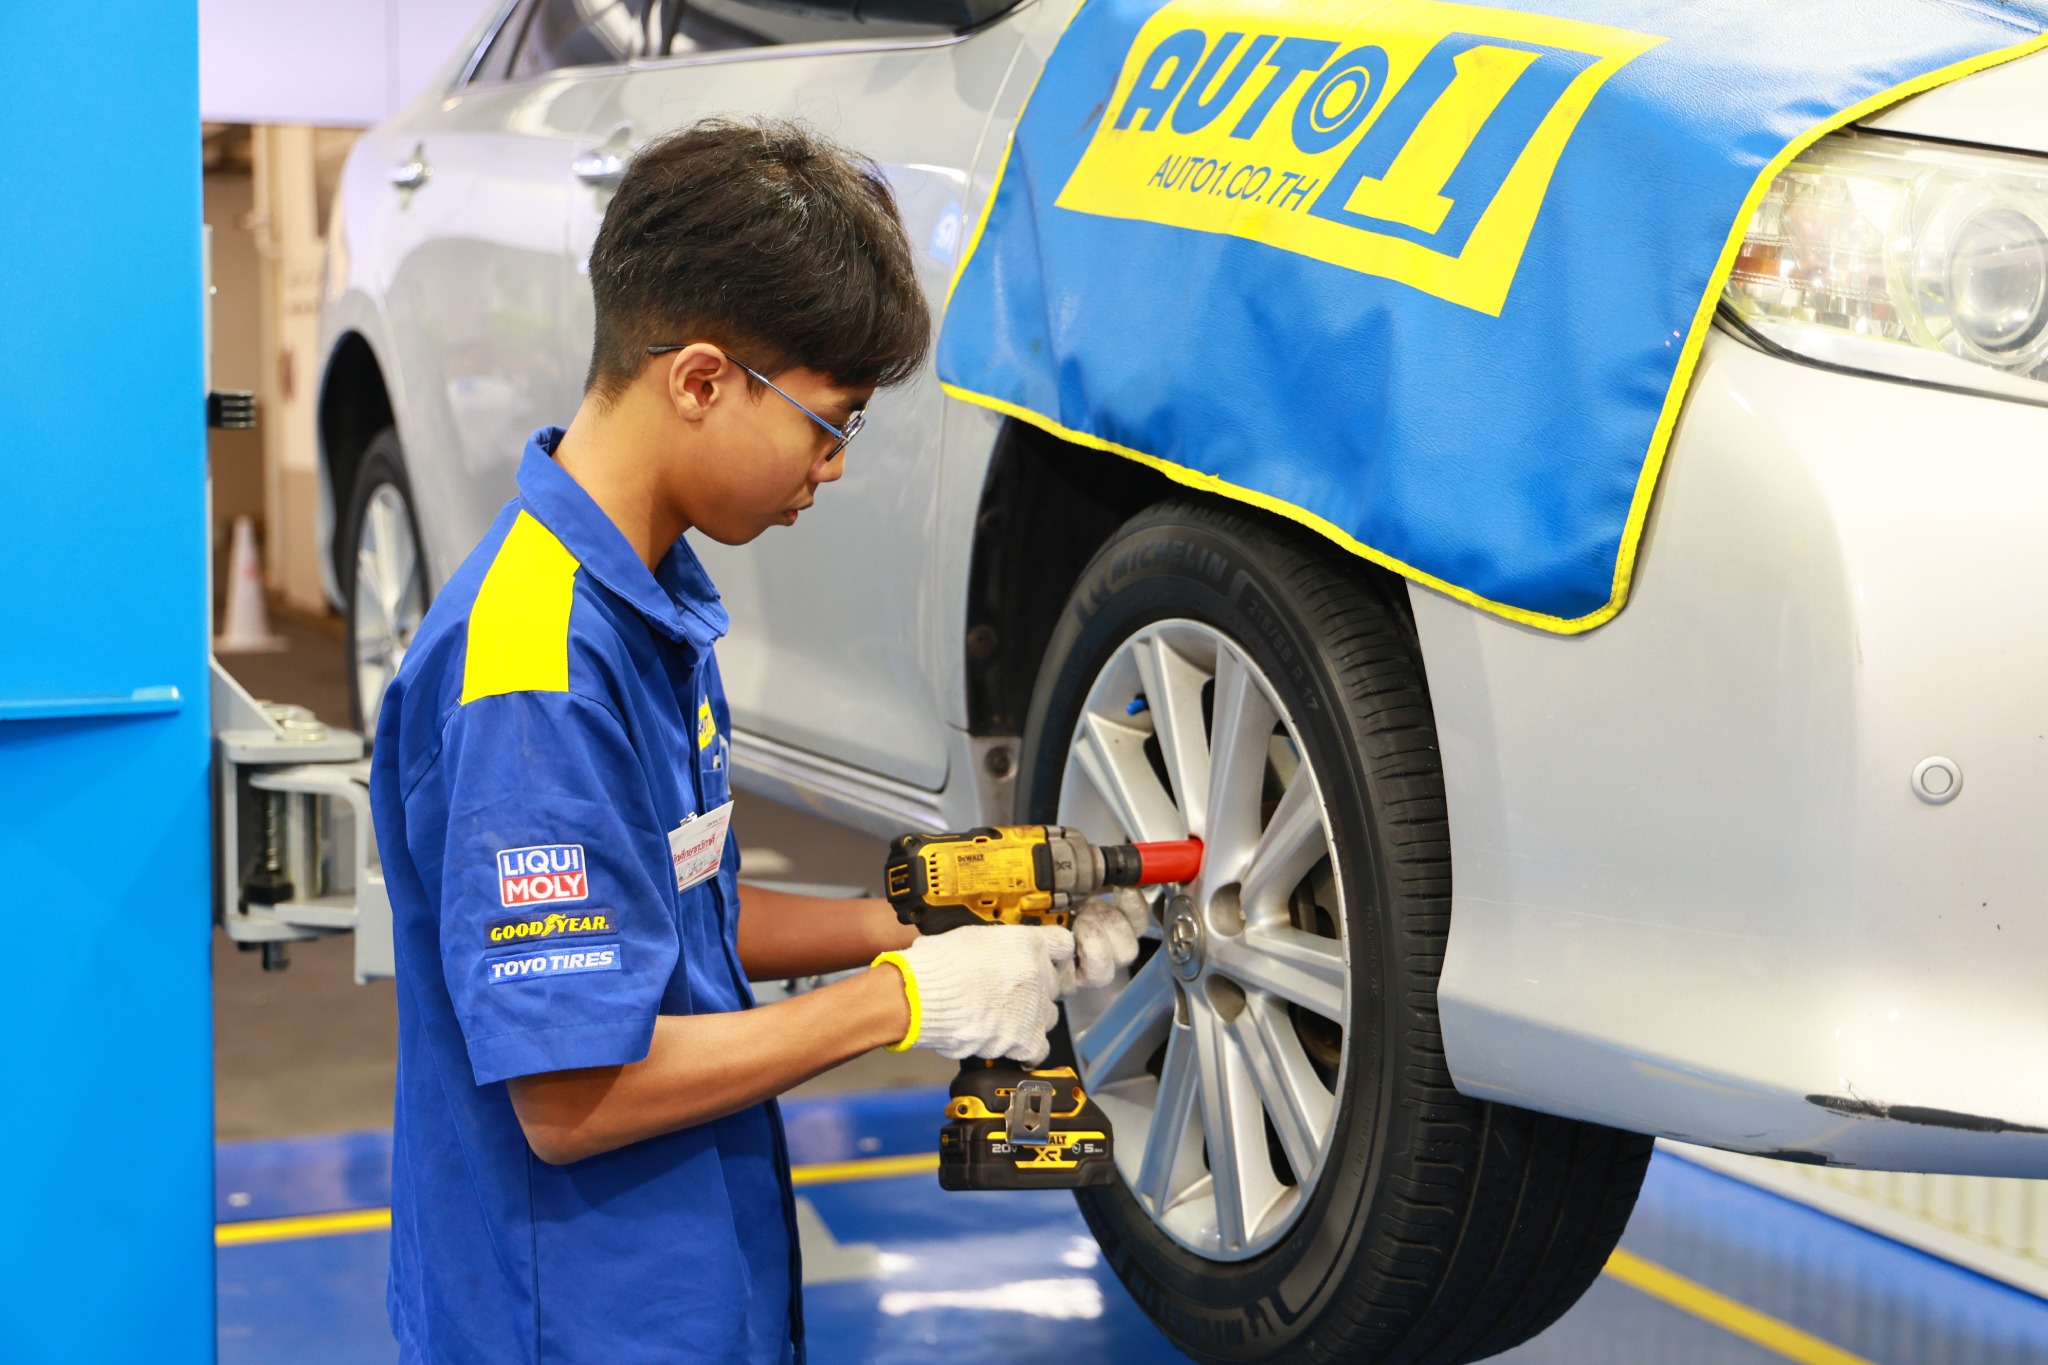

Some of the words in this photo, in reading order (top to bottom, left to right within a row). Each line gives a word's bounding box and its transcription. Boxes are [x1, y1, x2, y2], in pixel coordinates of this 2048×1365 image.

[1147, 154, 1320, 211] AUTO1.CO.TH
[1111, 539, 1229, 584] MICHELIN
[503, 849, 580, 876] LIQUI
[506, 874, 583, 902] MOLY
[492, 957, 547, 978] TOYO
[551, 951, 614, 970] TIRES
[1034, 1146, 1062, 1162] XR
